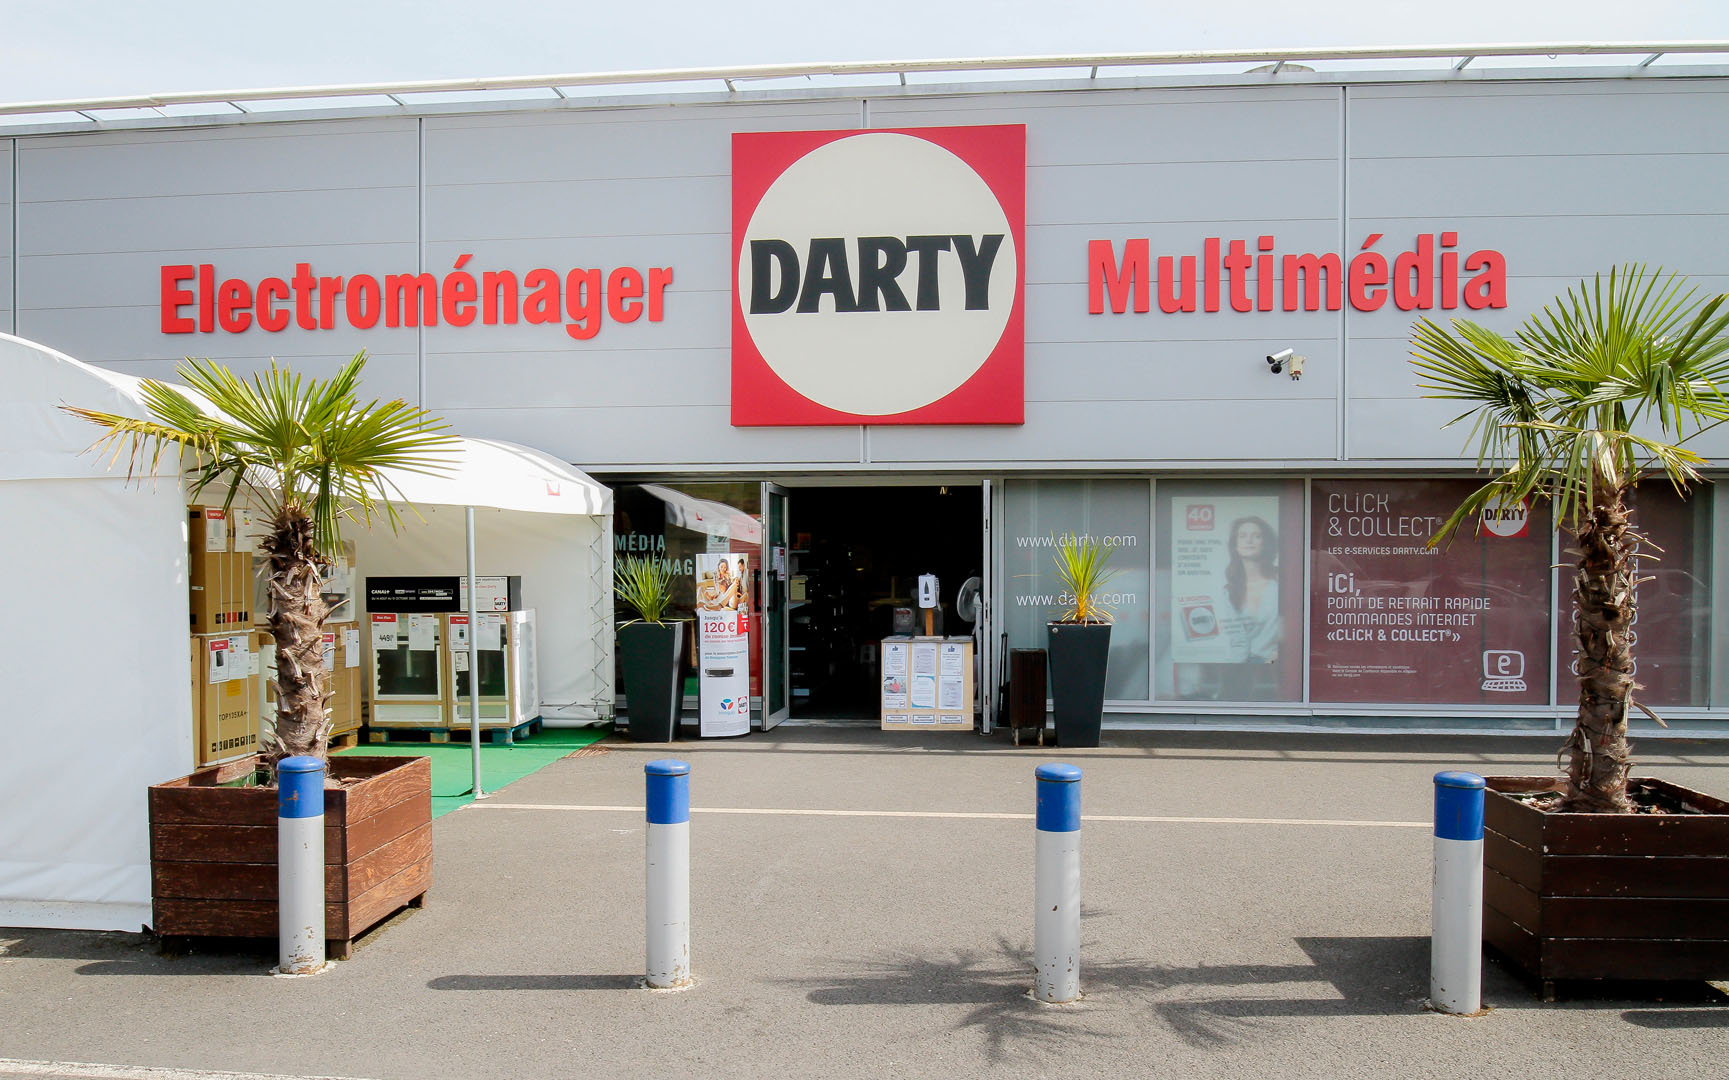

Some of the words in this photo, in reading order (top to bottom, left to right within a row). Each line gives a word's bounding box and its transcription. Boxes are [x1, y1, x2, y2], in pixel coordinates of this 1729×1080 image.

[750, 235, 1004, 314] DARTY
[1089, 232, 1507, 314] Multimédia
[161, 254, 673, 340] Electroménager
[1484, 508, 1525, 520] DARTY
[1328, 516, 1342, 536] &
[614, 530, 665, 551] MÉDIA
[1016, 532, 1137, 548] www.dartycom
[1016, 591, 1137, 607] www.day.com
[1368, 597, 1384, 609] DE
[1327, 613, 1413, 625] COMMANDES
[704, 622, 726, 633] 120
[1377, 629, 1387, 641] &
